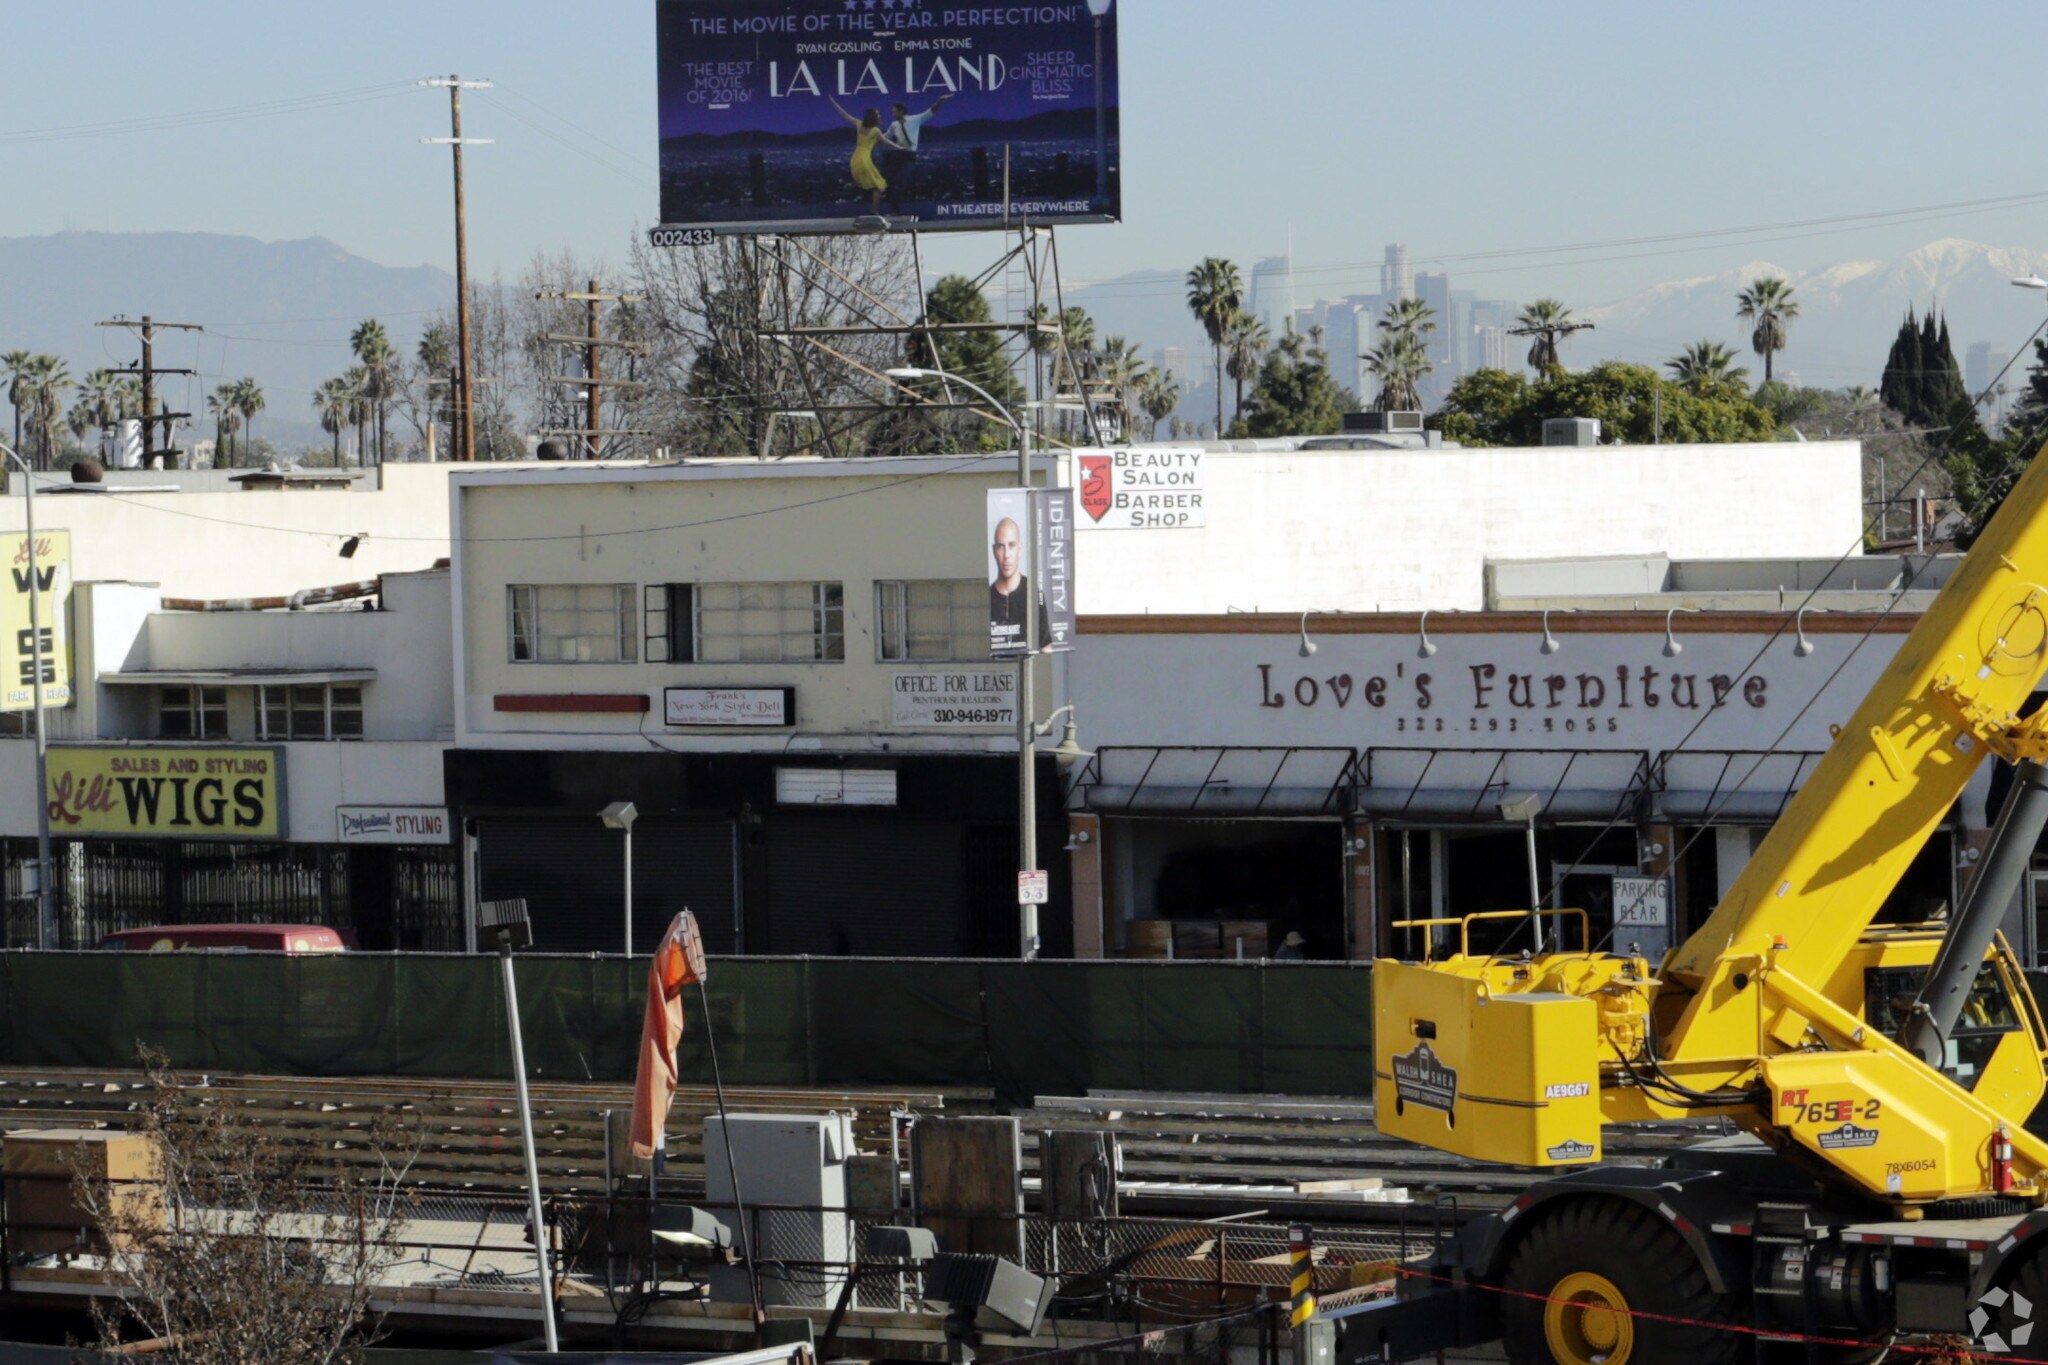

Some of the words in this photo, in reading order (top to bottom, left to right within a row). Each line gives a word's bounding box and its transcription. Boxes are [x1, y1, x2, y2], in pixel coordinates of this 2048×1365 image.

[689, 18, 728, 34] THE
[733, 15, 798, 33] MOVIE
[803, 14, 831, 31] OF
[837, 13, 875, 30] THE
[880, 11, 939, 29] YEAR.
[796, 43, 827, 54] RYAN
[829, 40, 882, 53] GOSLING
[894, 39, 930, 51] EMMA
[932, 37, 973, 50] STONE
[717, 61, 753, 76] BEST
[769, 59, 821, 97] LA
[837, 58, 889, 95] LA
[905, 53, 1006, 93] LAND
[1009, 63, 1093, 80] CINEMATIC
[694, 75, 743, 90] MOVIE
[686, 90, 707, 104] OF
[937, 204, 949, 214] IN
[952, 203, 1006, 215] THEATERS
[1010, 201, 1090, 213] EVERYWHERE
[653, 229, 713, 246] 002433
[1114, 451, 1201, 467] BEAUTY
[1123, 469, 1195, 485] SALON
[1115, 493, 1203, 509] BARBER
[1130, 511, 1189, 527] SHOP
[1050, 500, 1067, 610] IDENTITY
[894, 675, 938, 692] OFFICE
[944, 674, 968, 692] FOR
[974, 674, 1014, 692] LEASE
[1257, 662, 1432, 709] Love's
[1468, 663, 1768, 709] Furniture
[698, 701, 720, 711] York
[722, 701, 752, 714] Style
[933, 708, 1013, 723] 310-946-1977
[111, 757, 160, 773] SALES
[167, 758, 198, 773] AND
[205, 759, 267, 774] STYLING
[48, 770, 120, 825] Lili
[115, 777, 265, 827] WIGS
[395, 815, 442, 834] STYLING
[1614, 881, 1667, 898] PARKING
[1395, 1062, 1419, 1079] WALSH
[1431, 1071, 1454, 1089] SHEA
[1546, 1083, 1589, 1098] AE9G67
[1781, 1089, 1809, 1107] RT
[1793, 1098, 1881, 1124] 765E-2
[1885, 1159, 1936, 1174] 78X6054
